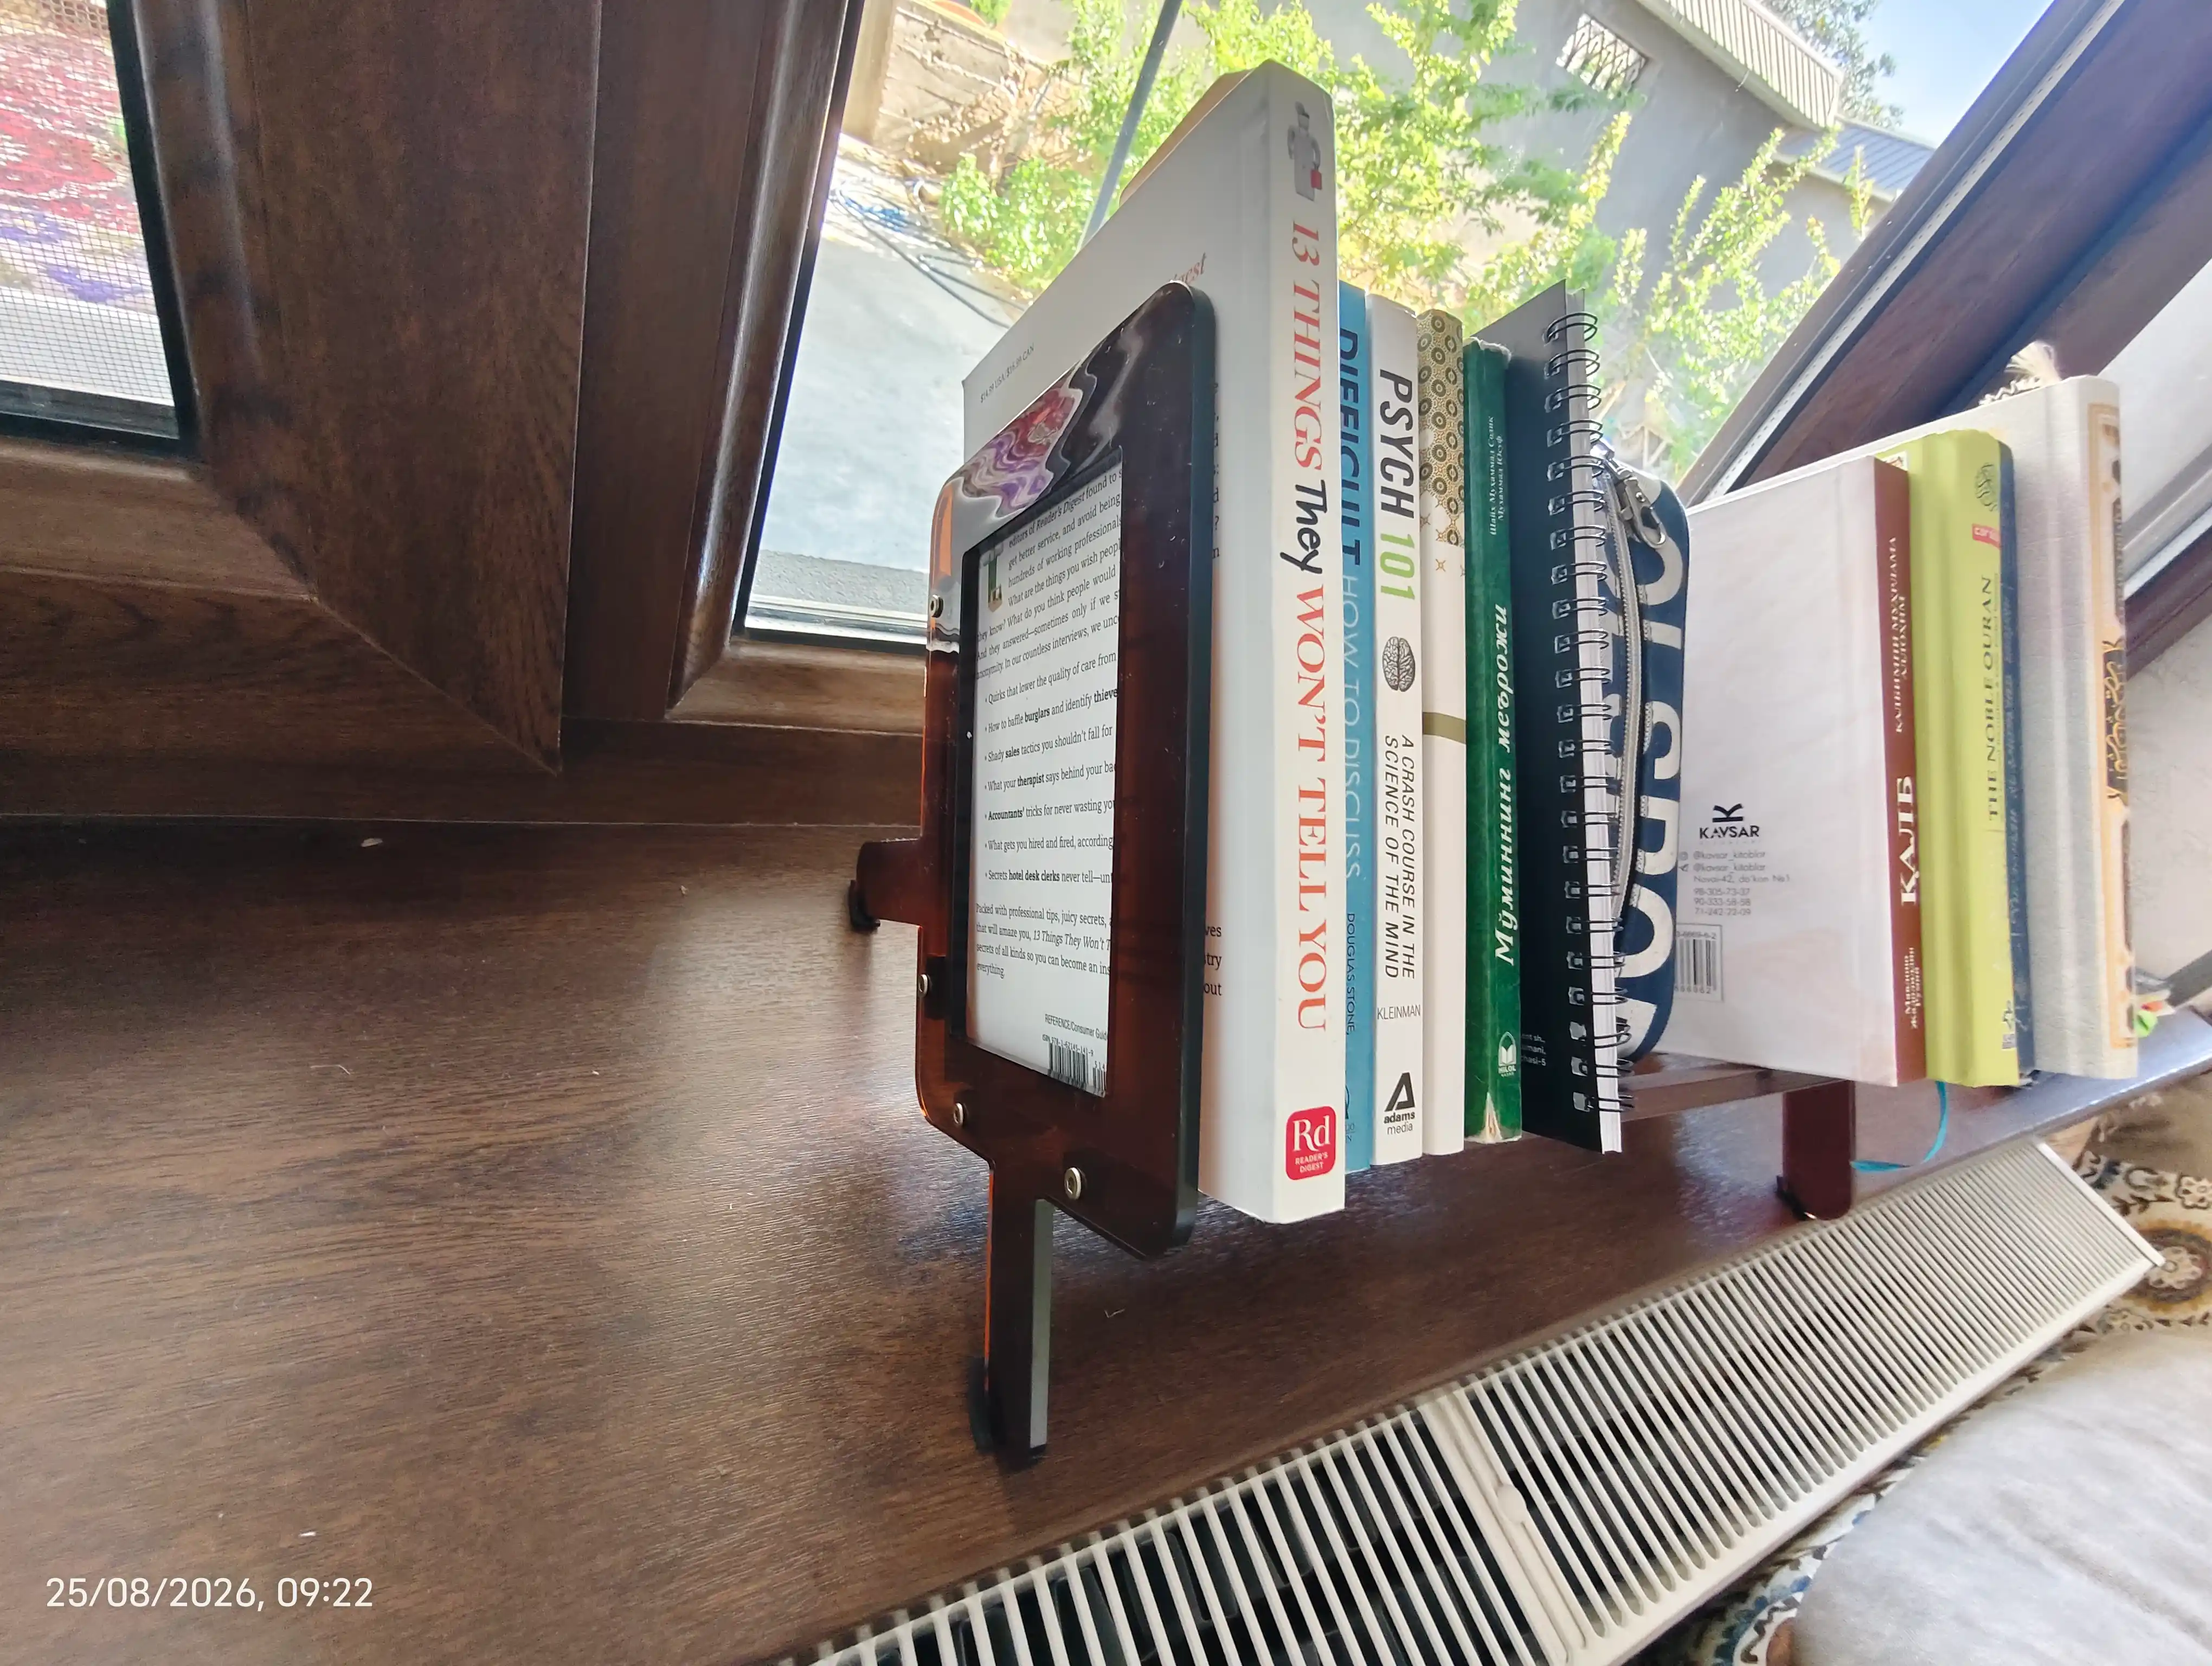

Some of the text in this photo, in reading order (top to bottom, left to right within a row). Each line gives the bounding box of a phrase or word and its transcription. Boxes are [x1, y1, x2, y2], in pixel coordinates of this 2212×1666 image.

[1036, 478, 1107, 531] Reader's Digest found
[1380, 369, 1416, 600] PSYCH 101
[1019, 494, 1121, 562] better service, and avoid being
[1008, 543, 1072, 588] hundreds working
[1008, 550, 1098, 607] What things you wish
[1007, 566, 1116, 628] What you think people would
[989, 643, 1000, 655] they
[1072, 603, 1087, 619] only
[1099, 594, 1110, 606] we
[1012, 621, 1101, 667] our countless interviews, we
[1279, 220, 1327, 1031] 13 THINGS They WON'T TELL YOU
[988, 652, 1116, 704] Quirks that lower the quality care from
[988, 693, 1092, 733] How baffle burglars and identify
[1984, 677, 1996, 761] NOBLE
[988, 724, 1113, 762] Shady sales tactics you shouldn't fall for
[988, 764, 1102, 792] What your therapist says behind your
[1987, 770, 1998, 821] THE
[988, 798, 1102, 821] Accountants' tricks for never wasting
[988, 834, 1113, 853] What gets you hired and fired, according
[1700, 825, 1760, 840] KAVSAR
[988, 869, 1080, 882] Secrets hotel desk clerks never
[1385, 735, 1399, 978] SCIENCE OF THE MIND
[1401, 734, 1415, 979] A CRASH COURSE IN THE
[1495, 767, 1519, 966] Мўминнинг
[976, 922, 987, 933] that
[988, 924, 998, 935] will
[999, 927, 1018, 938] amaze
[1019, 930, 1031, 942] you,
[1041, 931, 1063, 946] Things
[1064, 933, 1082, 950] They
[1083, 935, 1104, 950] Won't
[995, 905, 1007, 916] with
[1009, 906, 1044, 920] professional
[1046, 909, 1060, 924] tips,
[1062, 910, 1077, 926] juicy
[1079, 913, 1107, 928] secrets,
[976, 943, 994, 954] secrets
[1010, 946, 1025, 959] kinds
[1035, 953, 1046, 965] you
[1047, 955, 1059, 966] can
[1060, 954, 1087, 971] become
[1089, 962, 1098, 973] an
[1347, 913, 1355, 982] DOUGLAS
[1377, 1004, 1420, 1020] KLEINMAN
[1293, 1115, 1330, 1151] Rd
[1384, 1111, 1416, 1124] adams
[1387, 1122, 1413, 1136] media
[1295, 1152, 1328, 1165] READER'S
[1300, 1162, 1323, 1173] DIGEST
